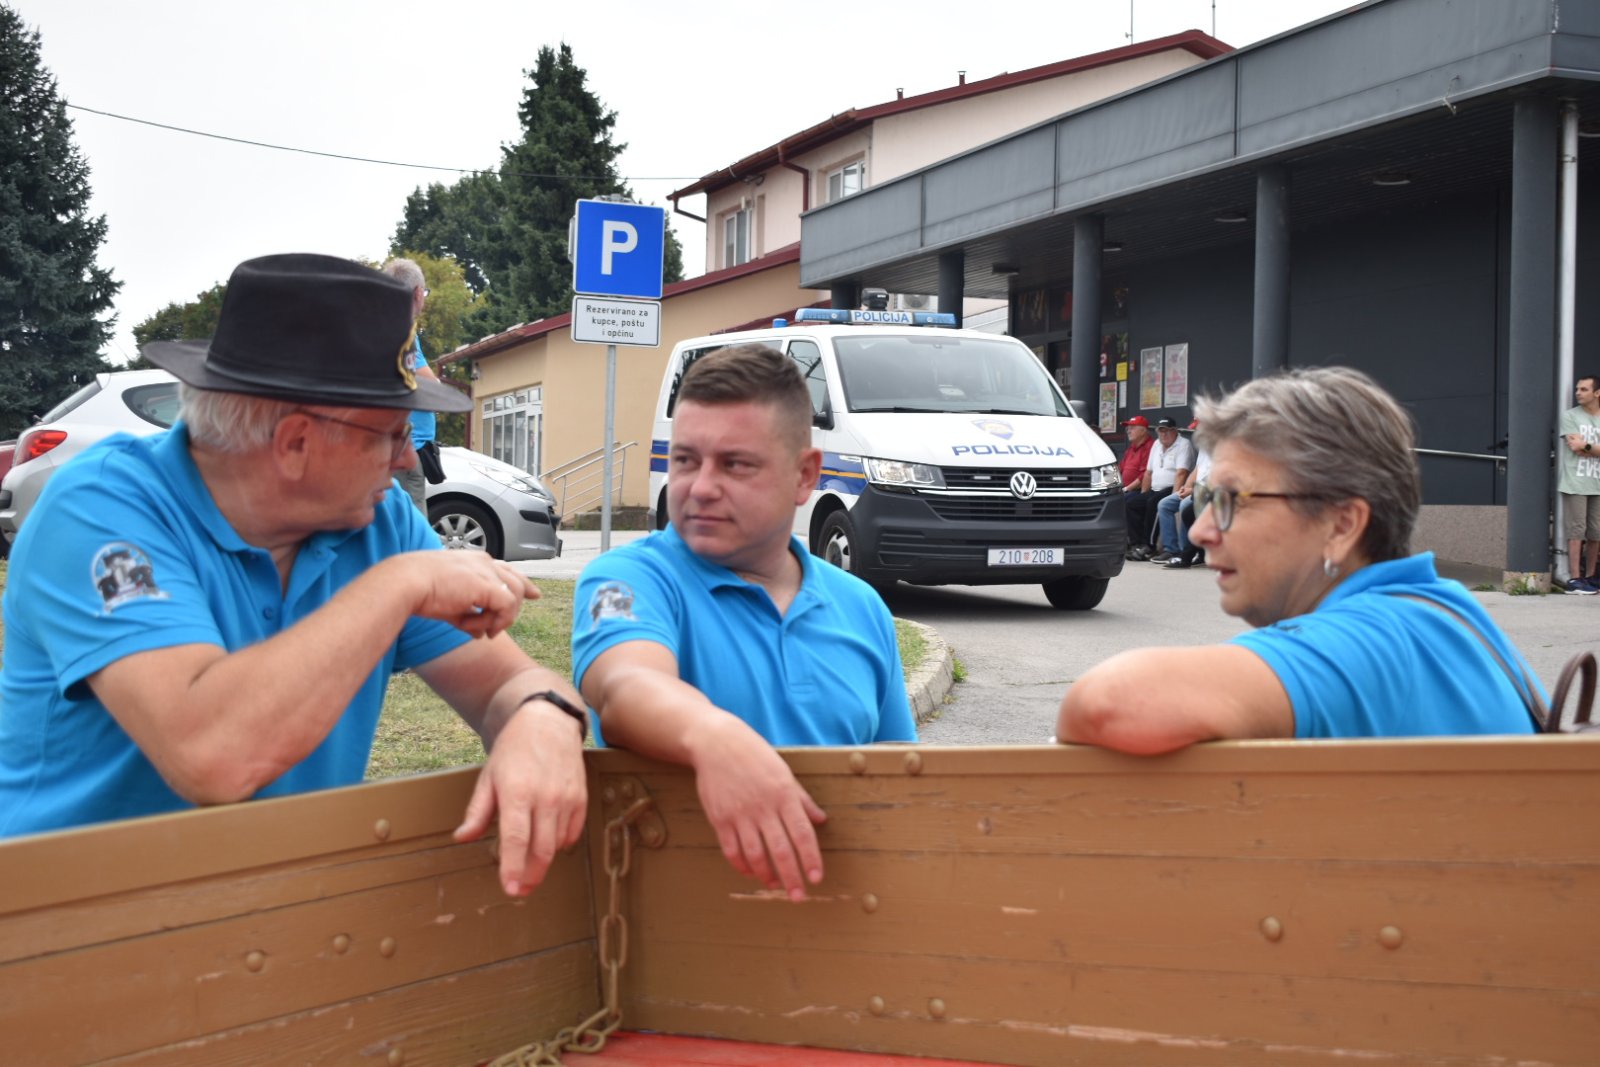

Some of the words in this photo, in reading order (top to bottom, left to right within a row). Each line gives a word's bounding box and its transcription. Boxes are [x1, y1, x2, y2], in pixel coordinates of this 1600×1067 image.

[601, 220, 638, 275] P
[586, 305, 636, 316] Rezervirano
[592, 316, 619, 326] kupce,
[621, 319, 645, 328] poštu
[854, 311, 910, 323] POLICIJA
[607, 329, 634, 338] općinu
[951, 445, 1075, 458] POLICIJA
[999, 550, 1022, 564] 210
[1032, 549, 1054, 563] 208
